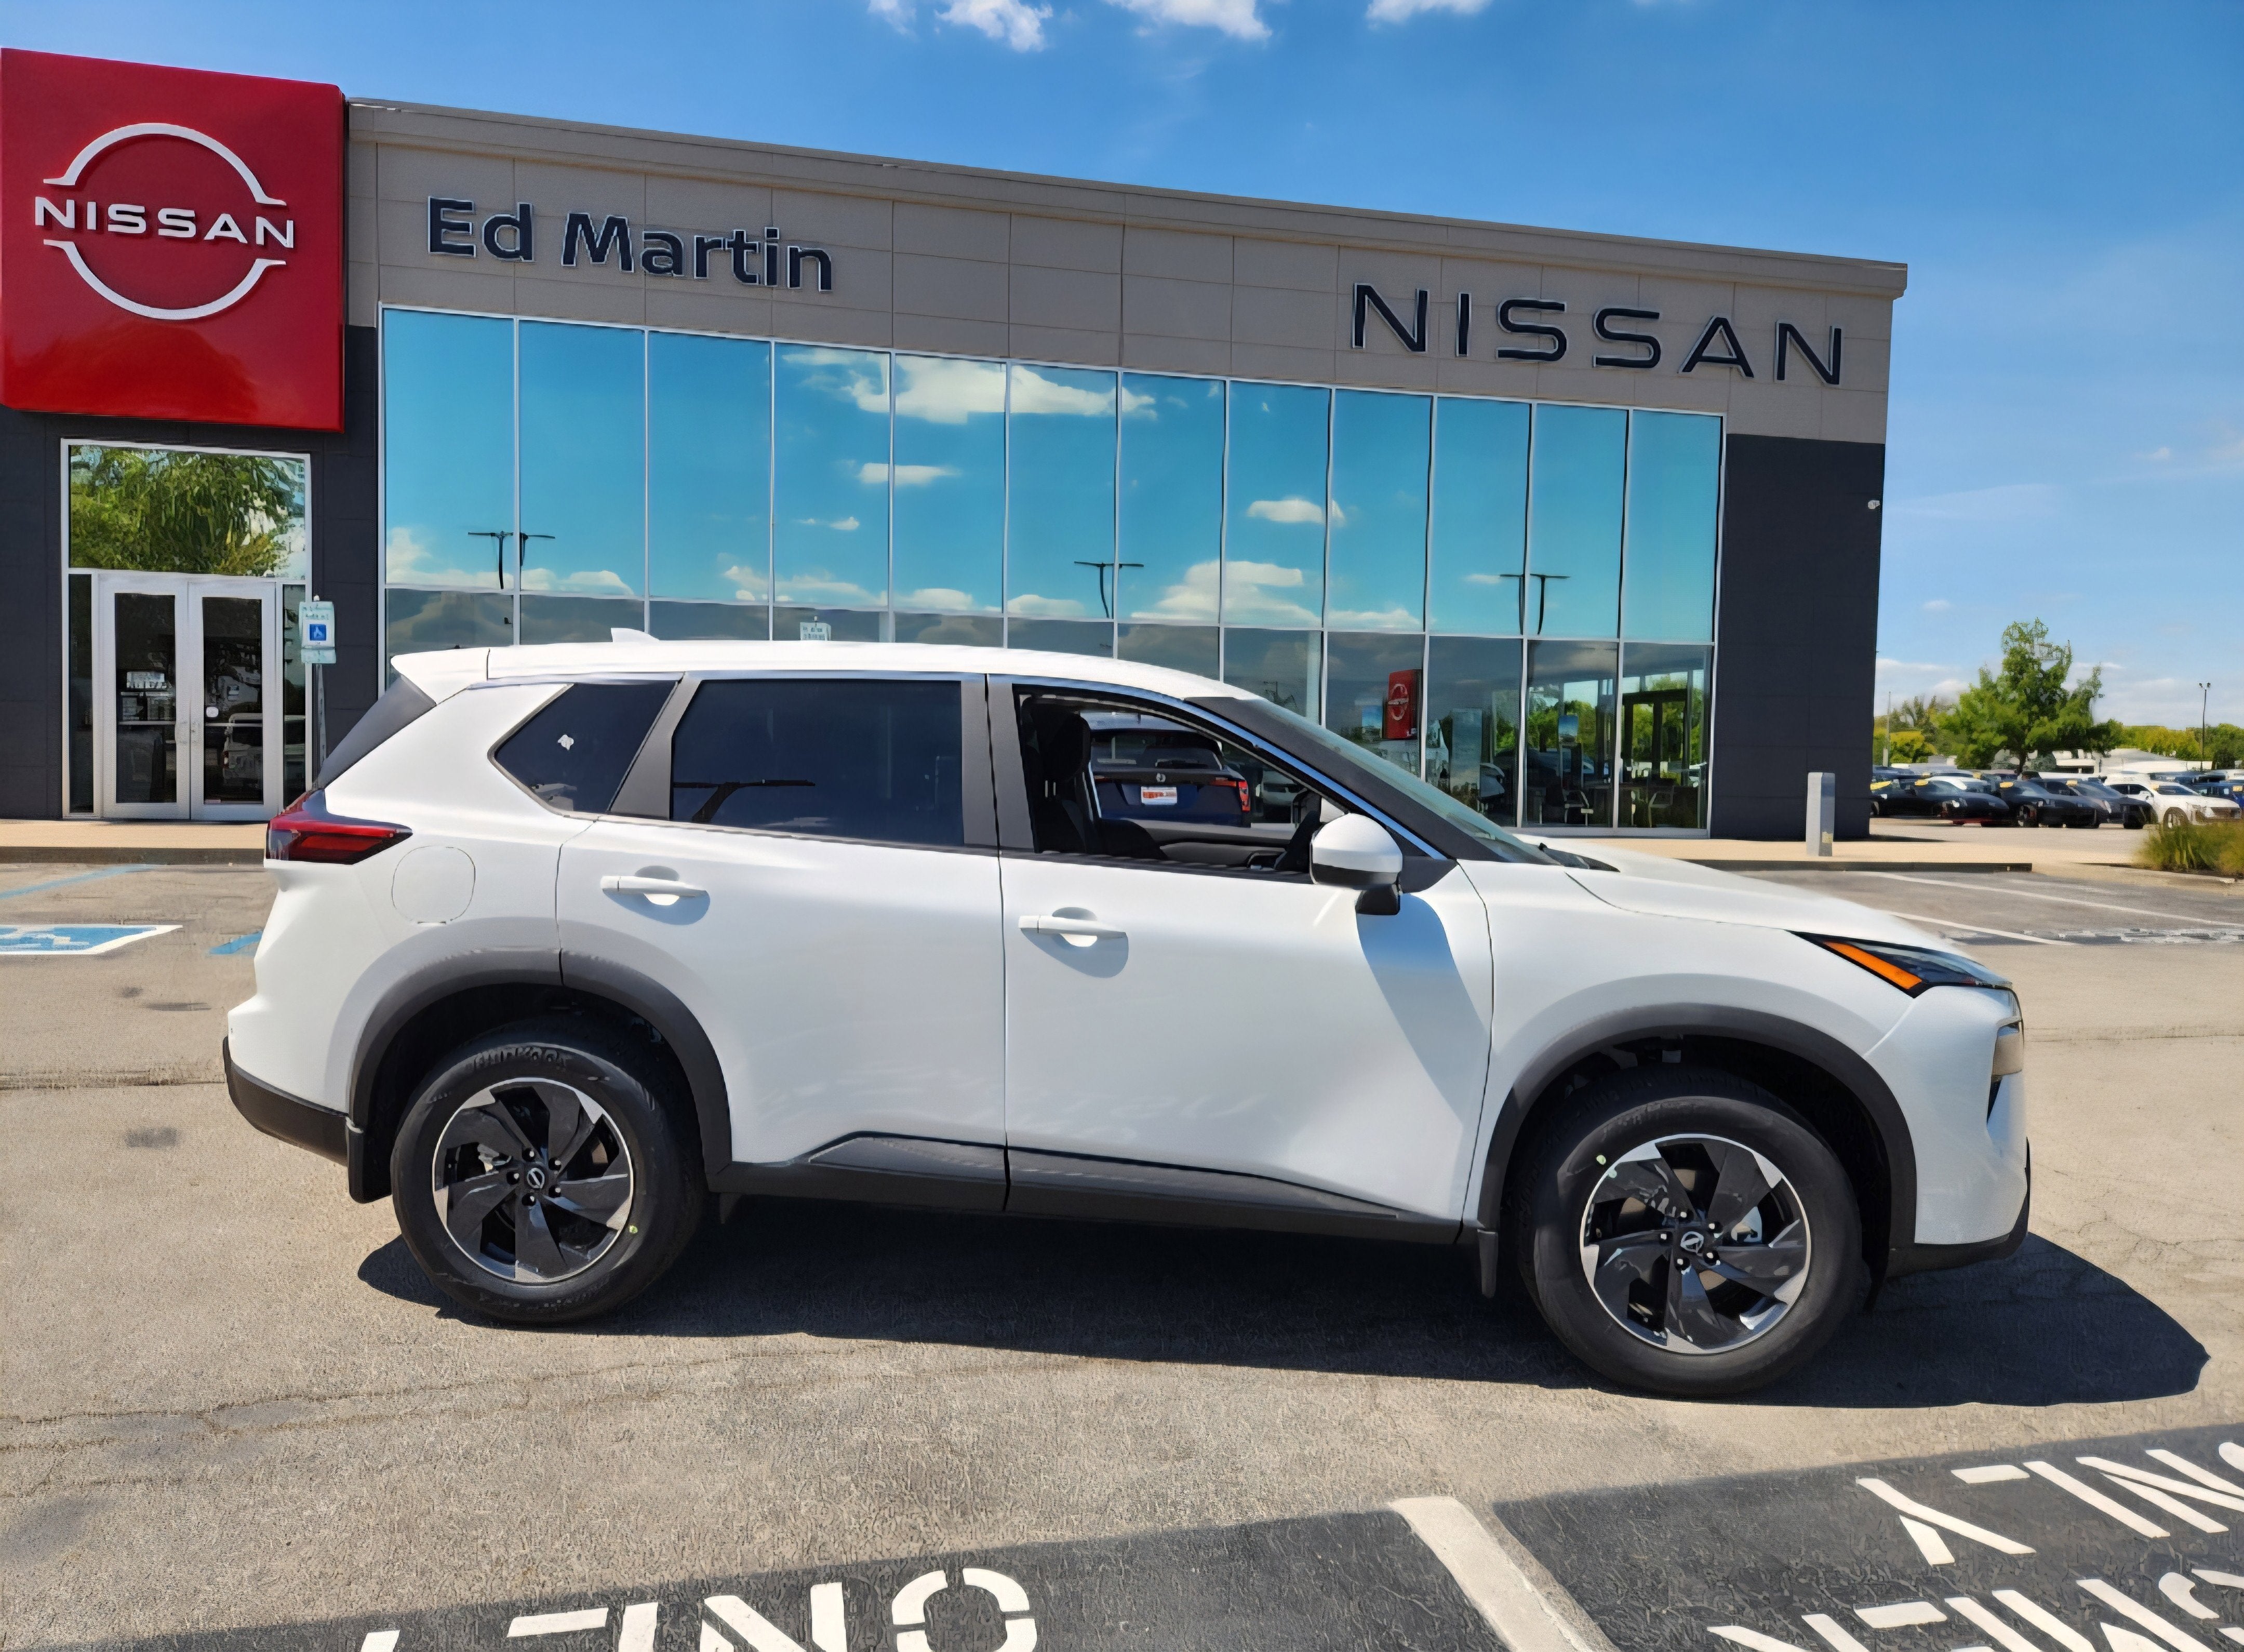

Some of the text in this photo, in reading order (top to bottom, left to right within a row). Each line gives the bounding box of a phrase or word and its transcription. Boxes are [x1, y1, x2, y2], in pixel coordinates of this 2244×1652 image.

[34, 196, 295, 249] NISSAN
[428, 195, 832, 292] Ed Martin
[1352, 282, 1844, 385] NISSAN
[1855, 1441, 2244, 1566] NLY
